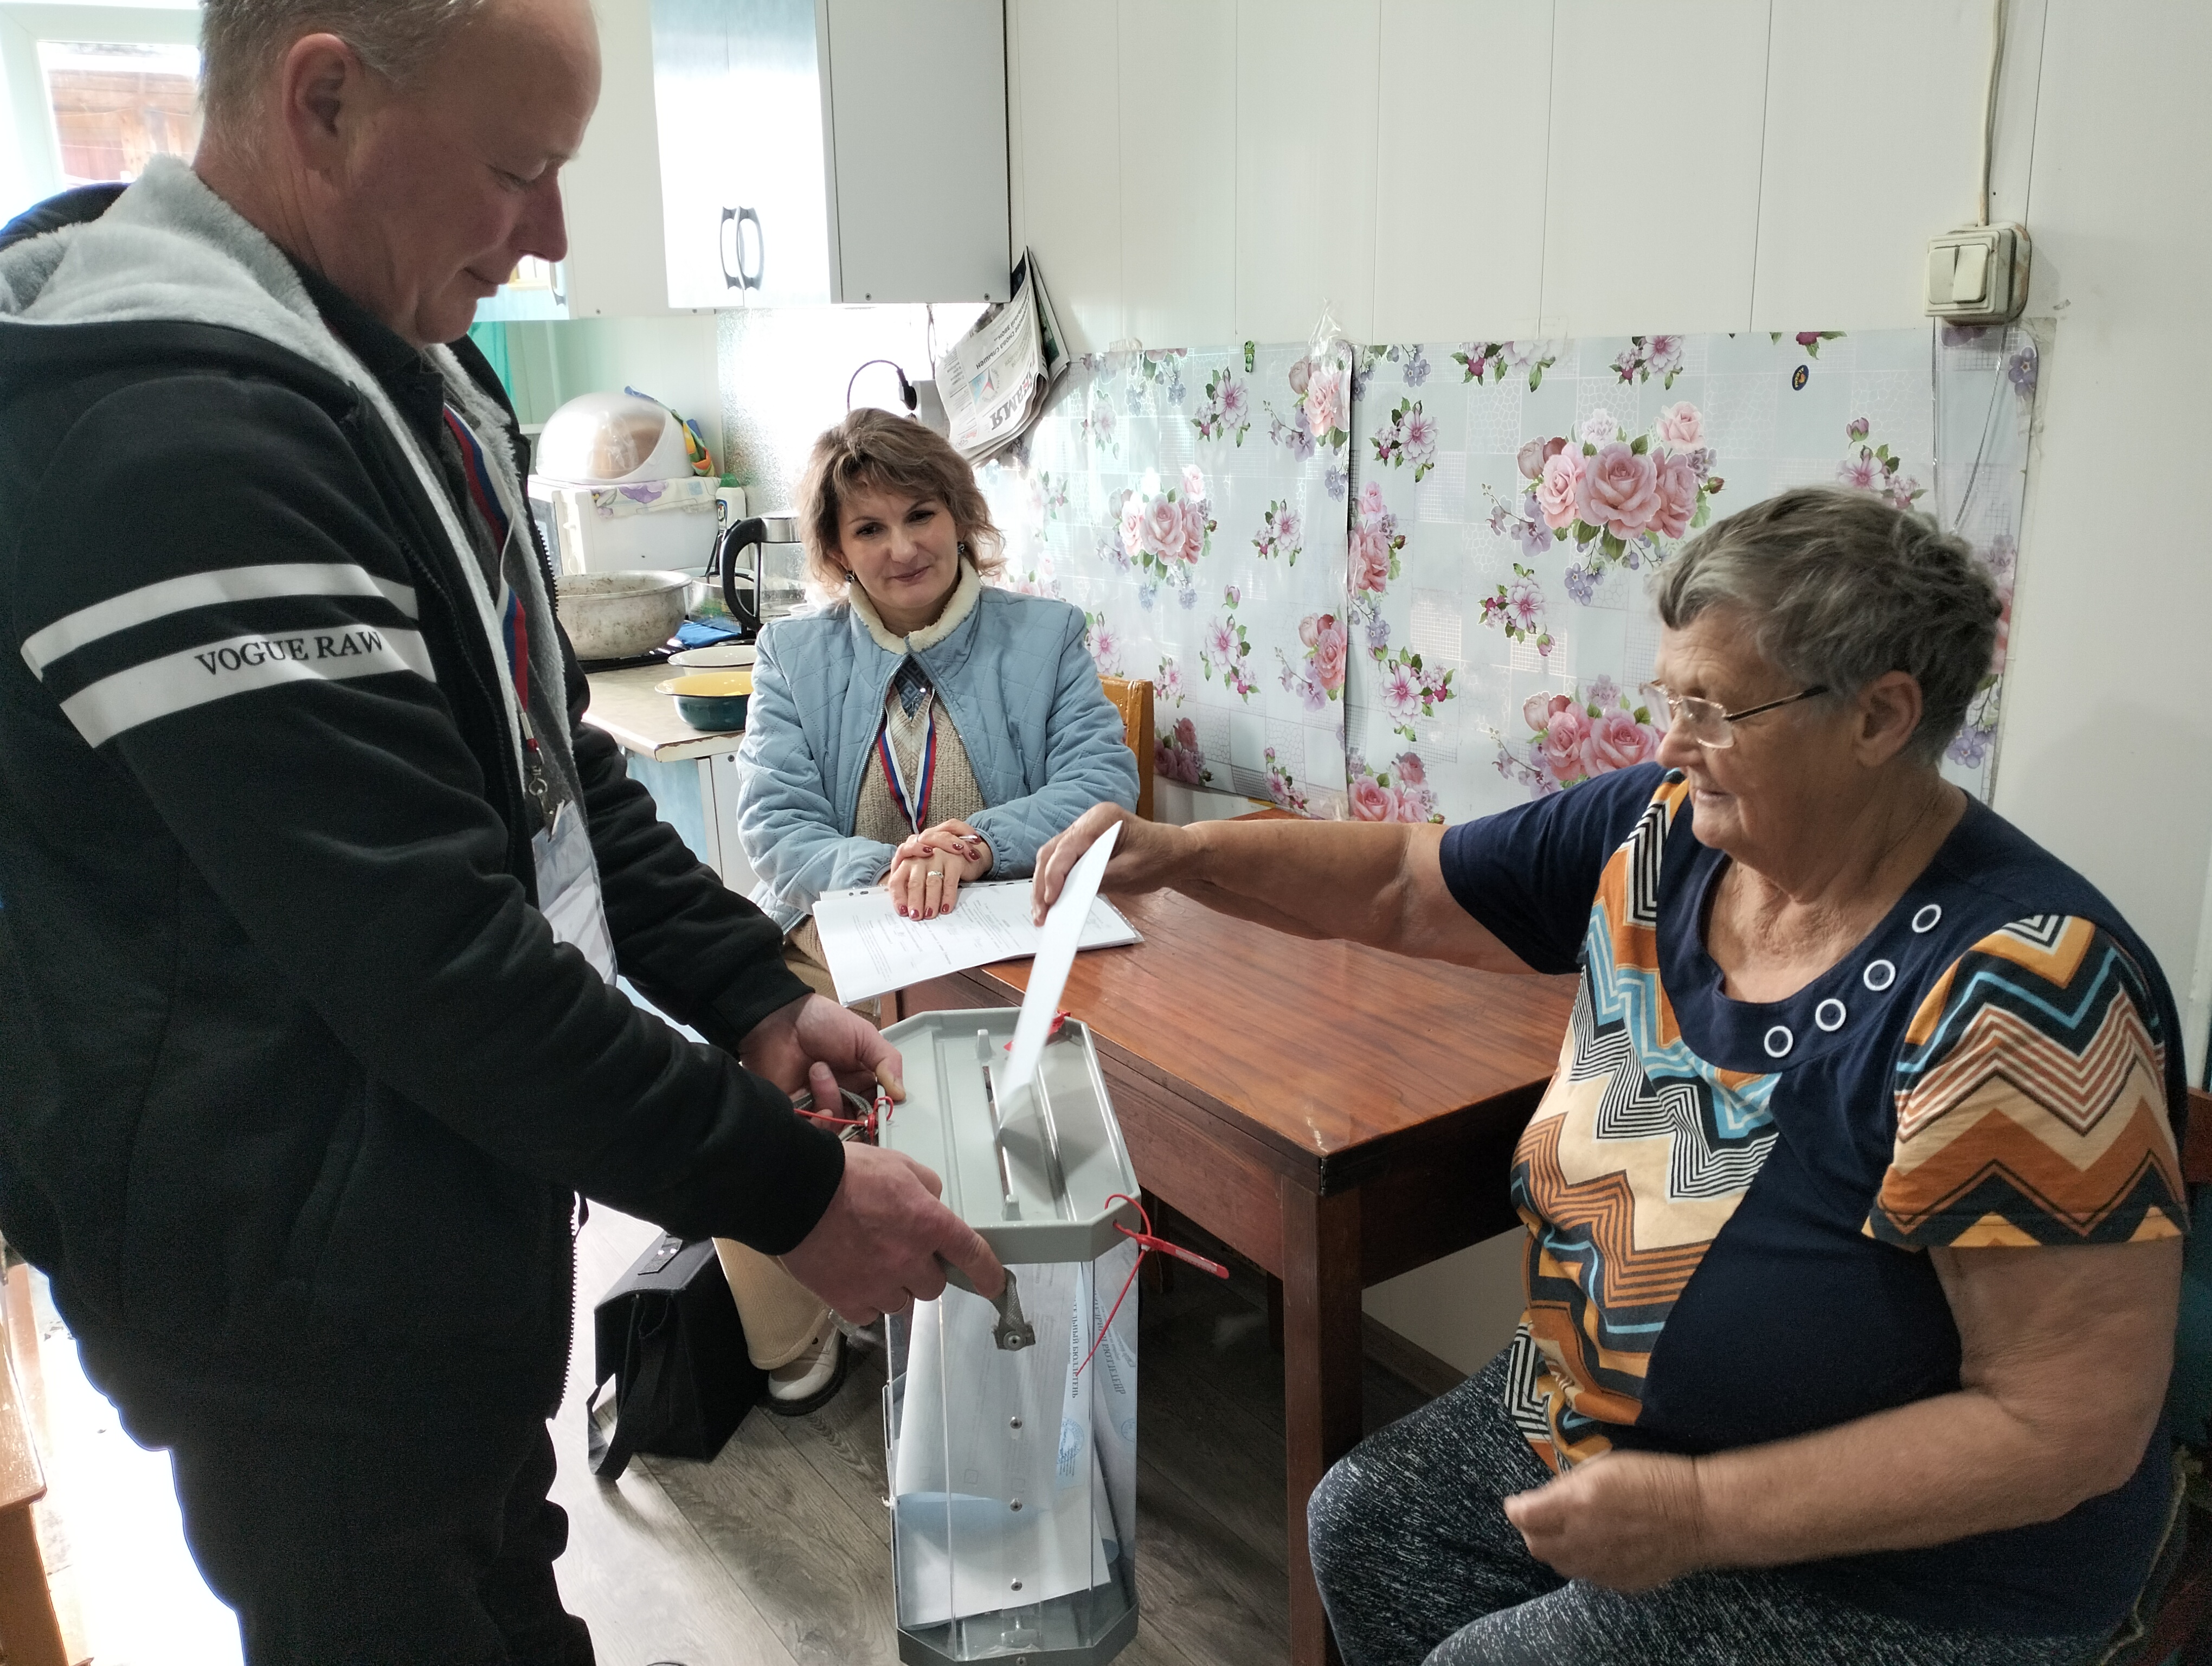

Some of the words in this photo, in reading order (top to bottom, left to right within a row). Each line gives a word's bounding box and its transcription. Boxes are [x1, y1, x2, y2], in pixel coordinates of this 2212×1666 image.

[1000, 331, 1015, 349] снова
[976, 347, 1000, 370] слышен
[195, 638, 309, 676] VOGUE
[314, 631, 382, 659] RAW
